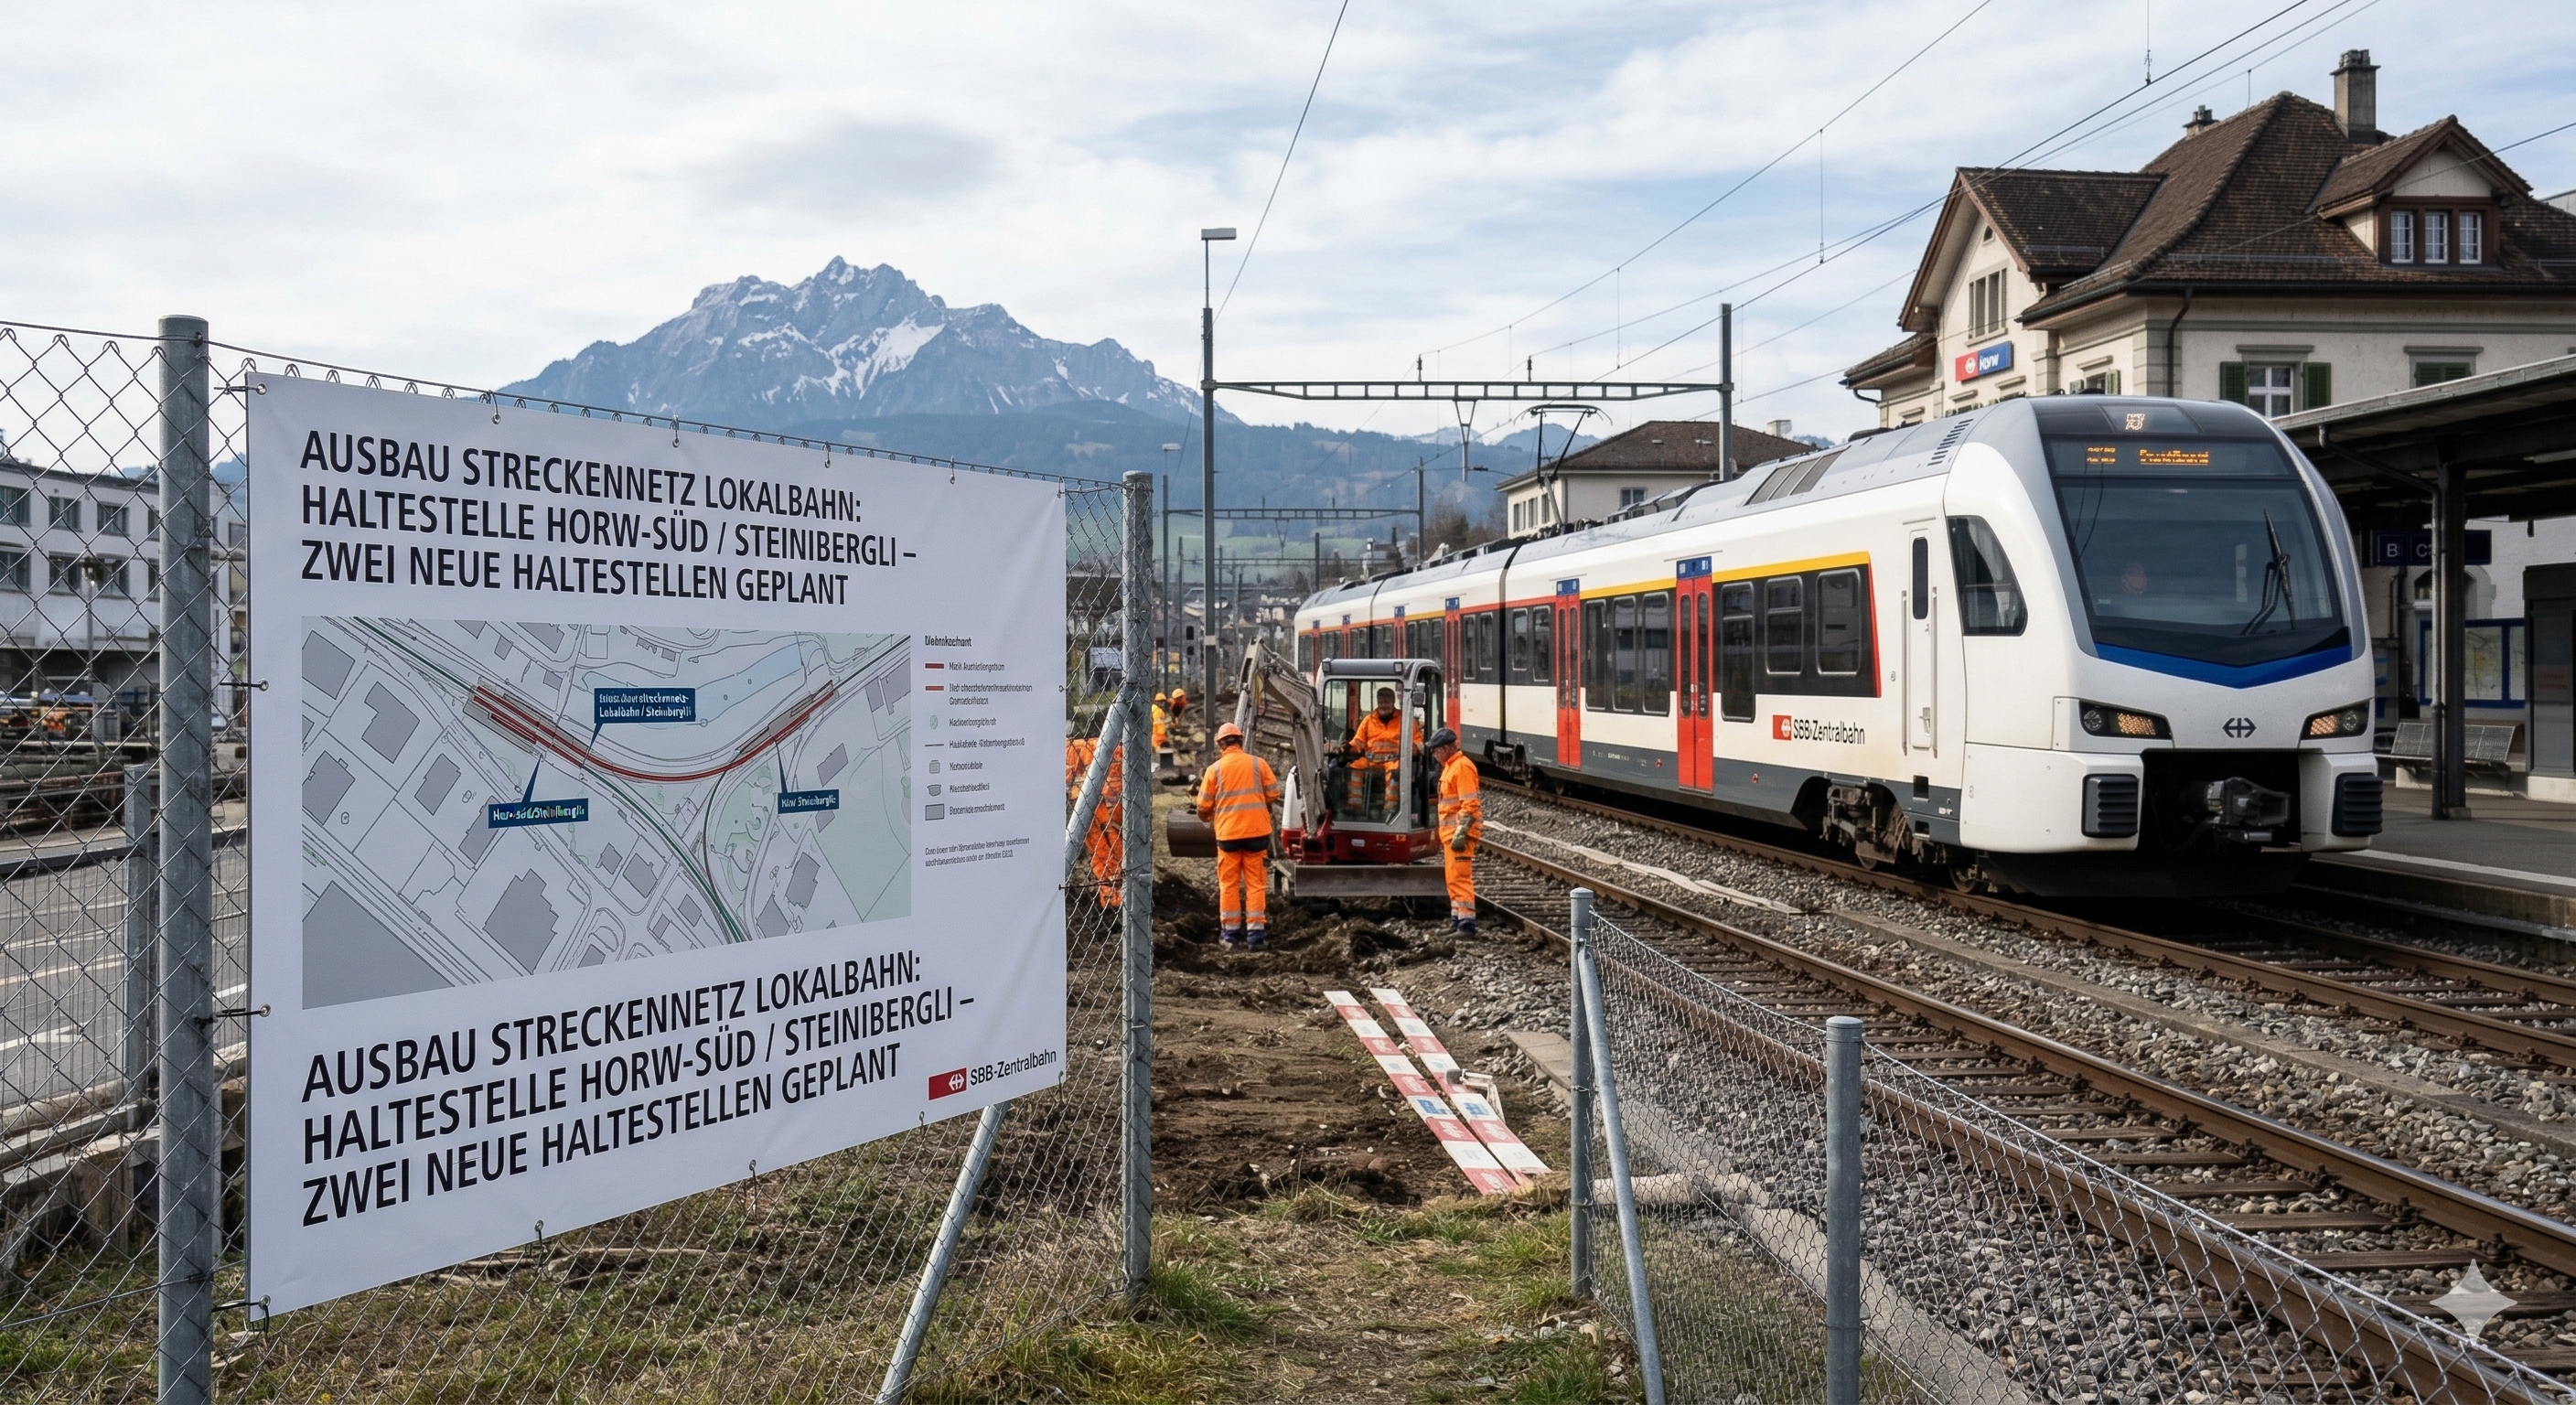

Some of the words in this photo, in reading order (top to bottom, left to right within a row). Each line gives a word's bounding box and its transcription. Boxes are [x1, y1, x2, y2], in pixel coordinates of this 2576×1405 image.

[299, 430, 450, 483] AUSBAU
[462, 447, 696, 507] STRECKENNETZ
[705, 475, 861, 523] LOKALBAHN:
[303, 484, 535, 541] HALTESTELLE
[547, 506, 708, 552] HORW-SÜD
[717, 521, 727, 555] /
[735, 523, 896, 567] STEINIBERGLI
[301, 539, 395, 585] ZWEI
[410, 546, 501, 589] NEUE
[513, 553, 726, 600] HALTESTELLEN
[735, 568, 849, 606] GEPLANT
[301, 1028, 476, 1103] AUSBAU
[491, 980, 746, 1067] STRECKENNETZ
[757, 949, 920, 1014] LOKALBAHN:
[970, 1048, 1057, 1087] SBB-Zentralbahn
[305, 1067, 567, 1165] HALTESTELLE
[581, 1030, 756, 1103] HORW-SÜD
[765, 1023, 776, 1063] /
[785, 986, 952, 1056] STEINIBERGLI
[303, 1157, 410, 1228] ZWEI
[427, 1131, 528, 1196] NEUE
[542, 1073, 771, 1168] HALTESTELLEN
[781, 1042, 901, 1104] GEPLANT
